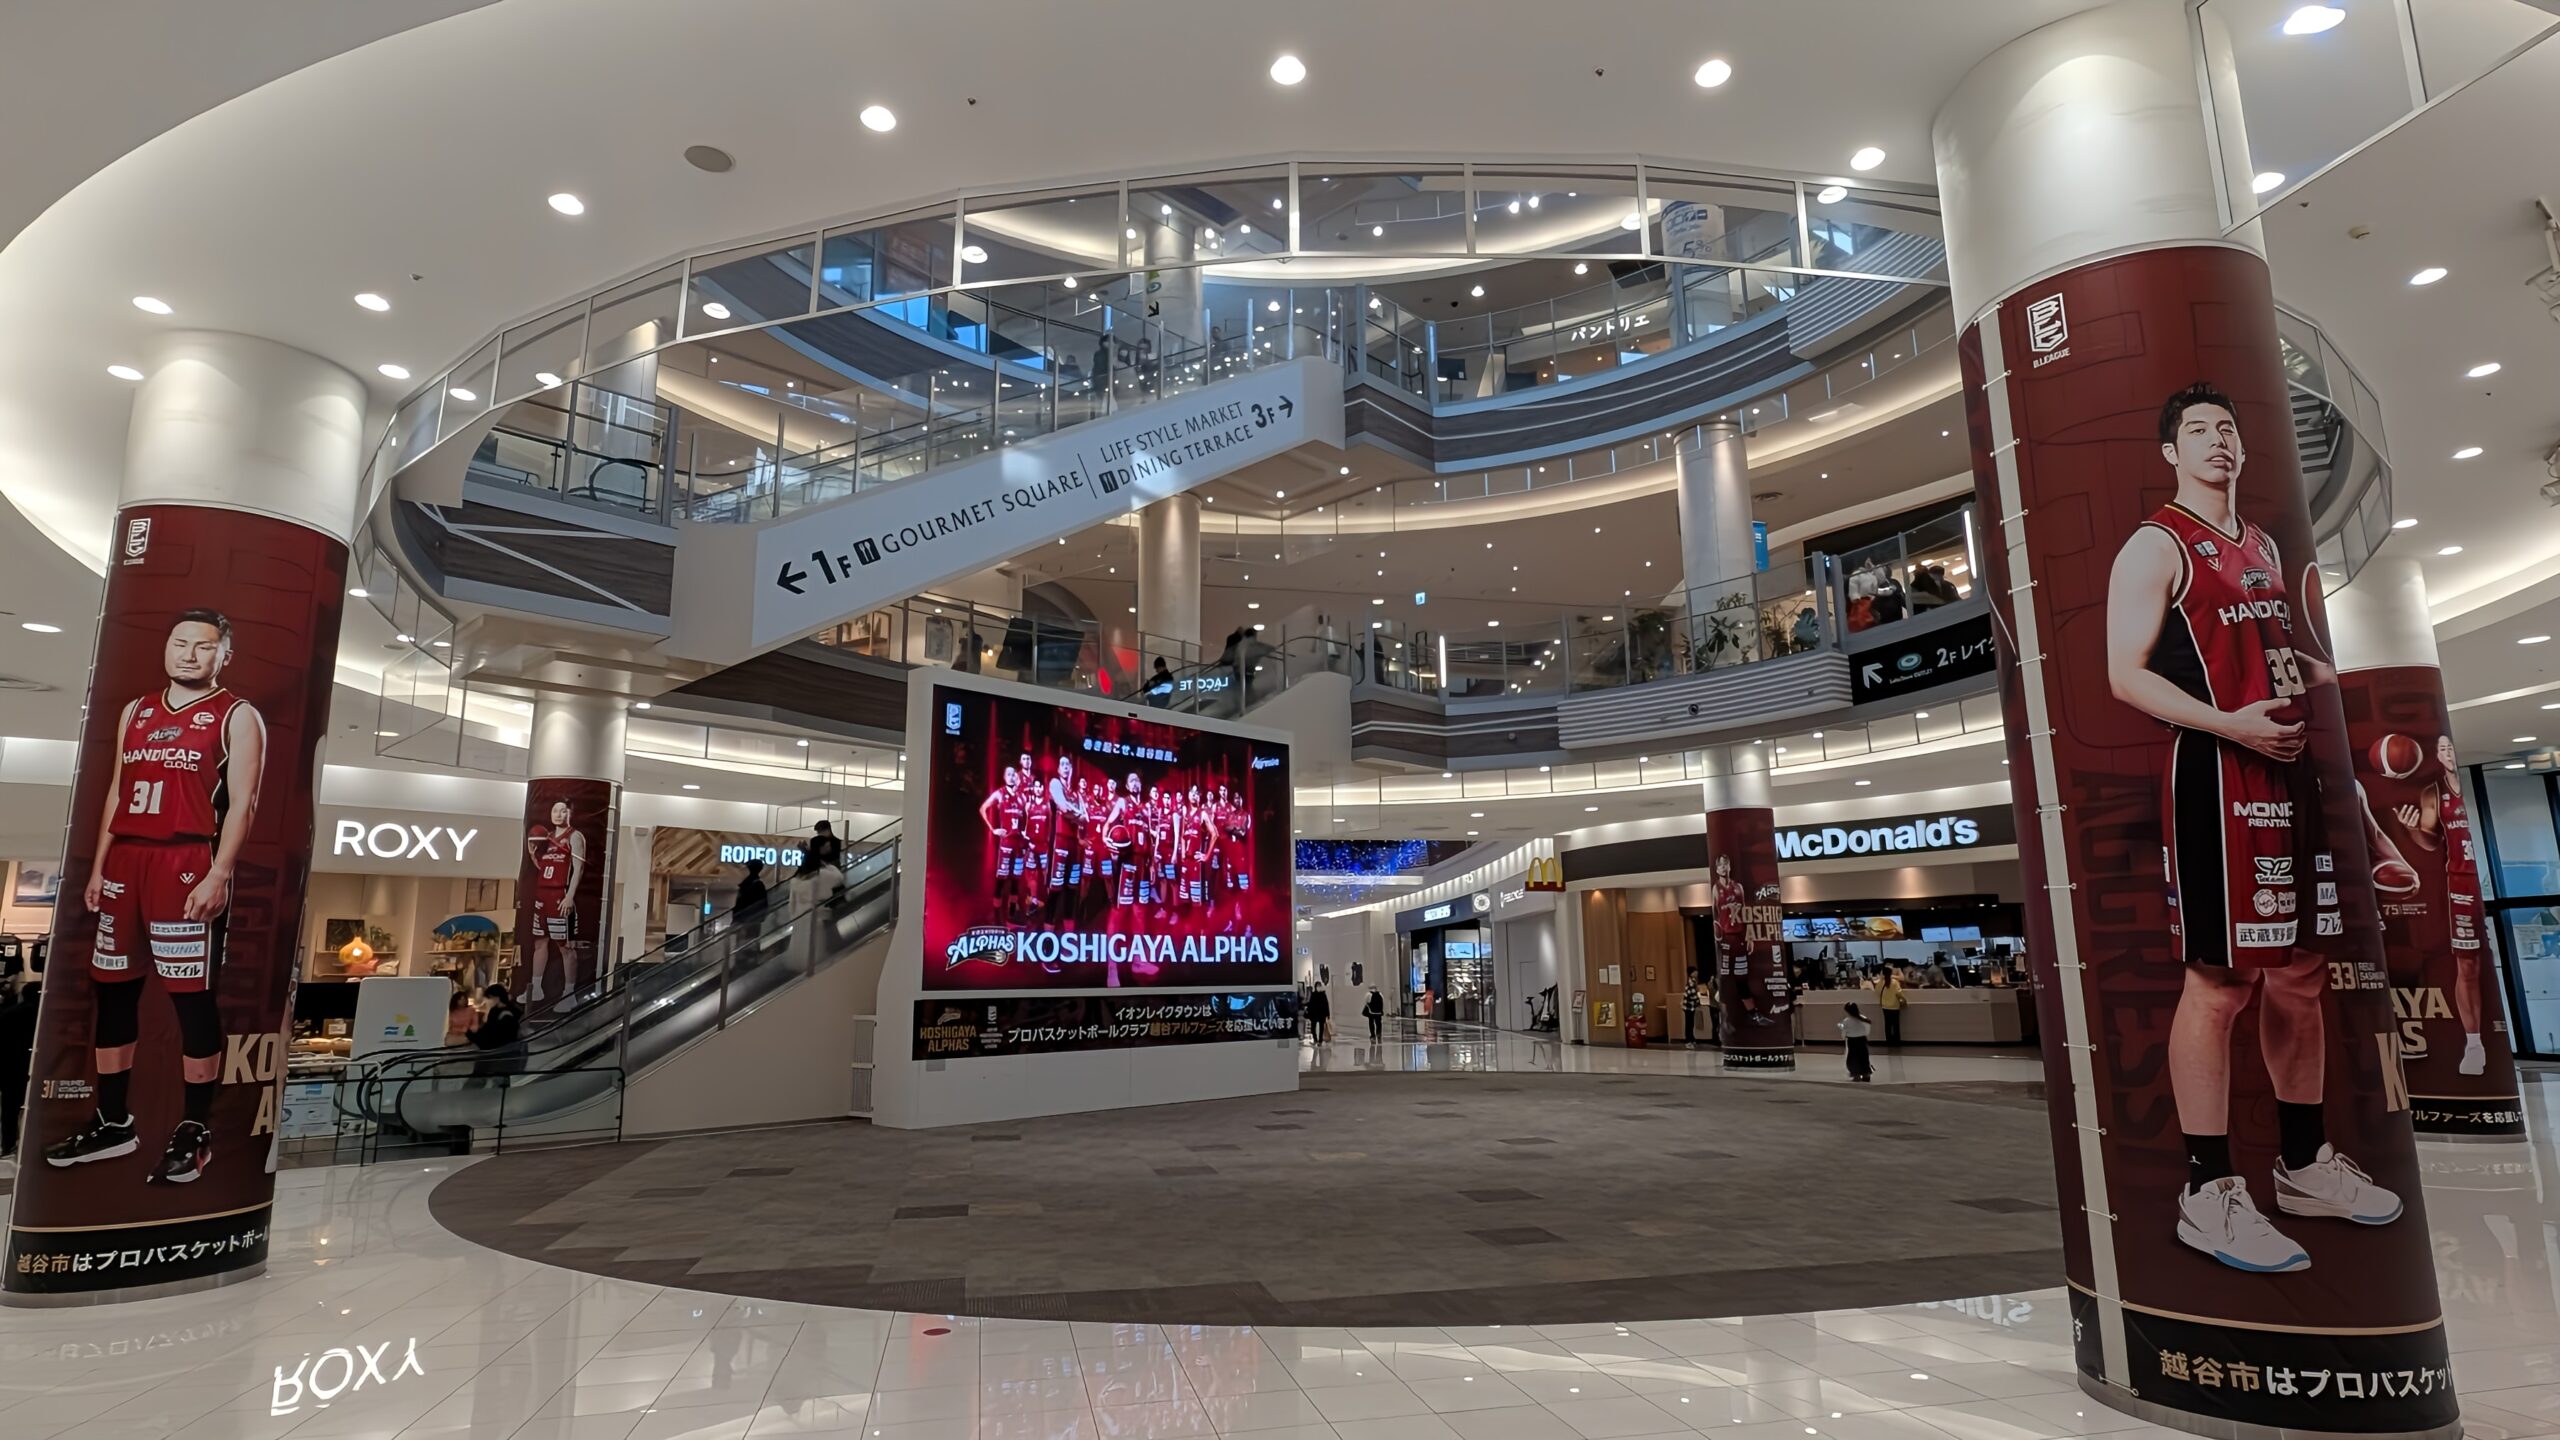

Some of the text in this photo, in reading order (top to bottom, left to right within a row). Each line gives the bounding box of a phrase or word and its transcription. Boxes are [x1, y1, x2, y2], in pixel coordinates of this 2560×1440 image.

[1571, 315, 1650, 341] パントリエ
[1100, 402, 1275, 463] LIFE STYLE MARKET 3F
[1118, 425, 1253, 485] DINING TERRACE
[811, 470, 1083, 584] 1F GOURMET SQUARE
[1937, 648, 1956, 667] 2F
[2265, 648, 2306, 697] 33
[123, 748, 202, 764] HANDICAP
[164, 760, 198, 771] CLOUD
[129, 780, 164, 814] 31
[2248, 818, 2291, 828] RENTAL
[333, 820, 478, 861] ROXY
[1774, 817, 1979, 859] McDonald's
[720, 845, 805, 867] RODEO CR
[947, 934, 1014, 965] ALPHAS
[1017, 932, 1279, 963] KOSHIGAYA ALPHAS
[2328, 962, 2356, 990] 33
[1115, 1004, 1212, 1021] イオンレイクタウンは
[920, 1025, 977, 1039] KOSHIGAYA
[928, 1039, 970, 1052] ALPHAS
[2397, 1021, 2428, 1053] S
